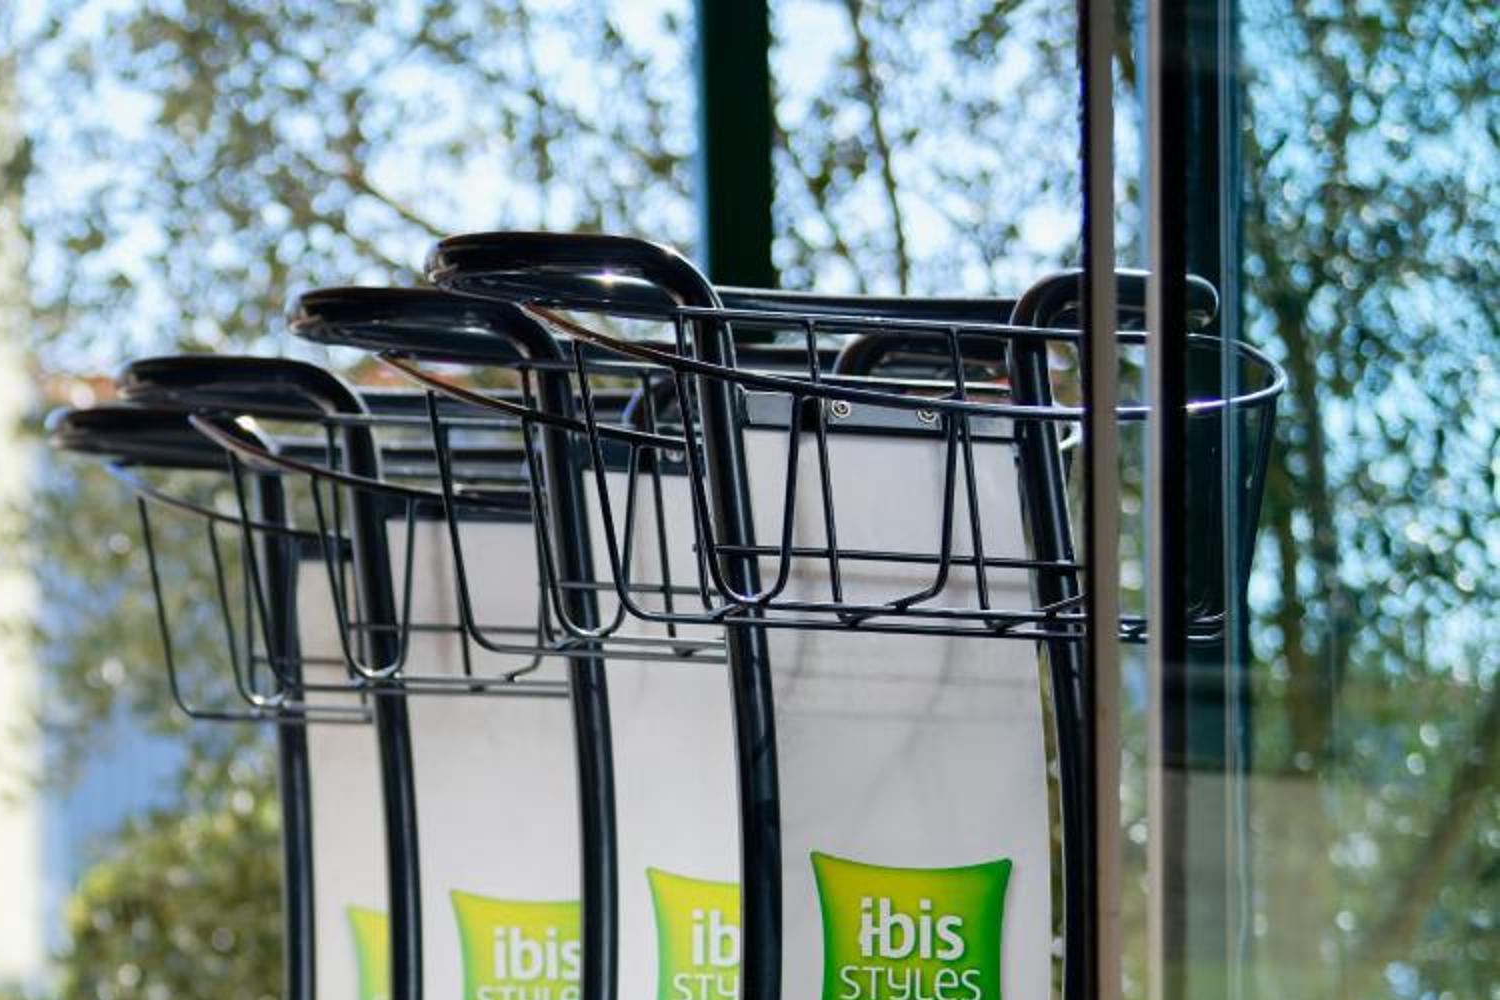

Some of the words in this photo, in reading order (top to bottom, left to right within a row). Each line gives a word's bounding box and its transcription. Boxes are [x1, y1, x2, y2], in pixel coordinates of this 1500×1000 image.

[493, 927, 581, 981] ibis
[691, 908, 740, 968] ib
[858, 897, 965, 960] ibis
